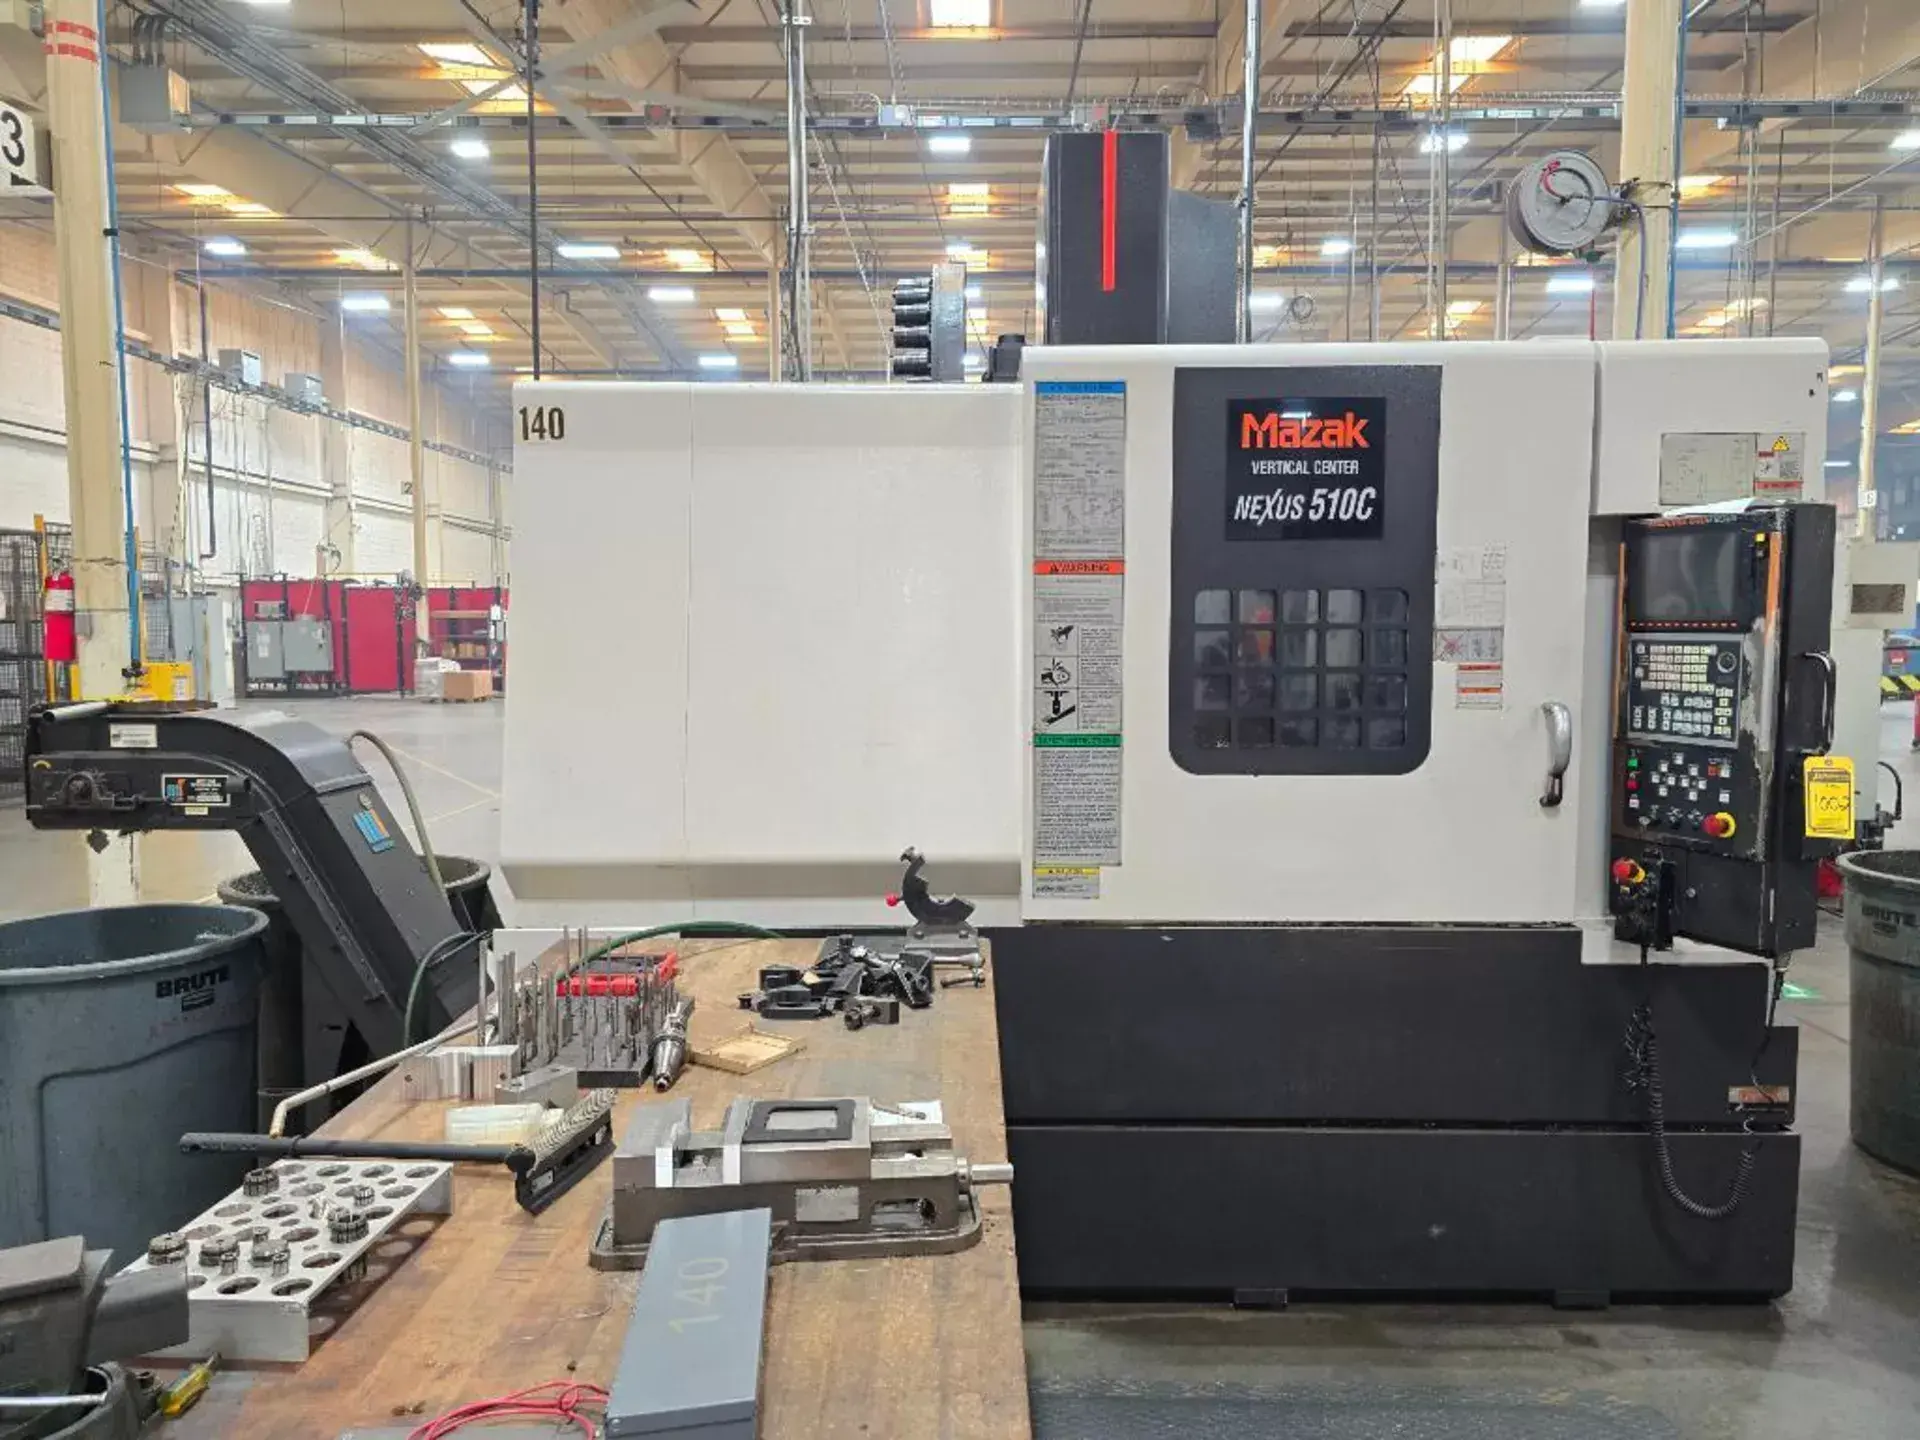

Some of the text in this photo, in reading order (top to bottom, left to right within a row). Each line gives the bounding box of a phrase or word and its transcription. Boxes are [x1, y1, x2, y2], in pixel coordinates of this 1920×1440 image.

[1, 110, 25, 167] 3
[518, 406, 565, 441] 140
[1241, 412, 1371, 449] Mazak
[1251, 459, 1360, 475] VERTICAL CENTER
[1234, 486, 1378, 527] NEXUS 510C
[156, 965, 230, 999] BRUTE
[668, 1257, 730, 1334] 140
